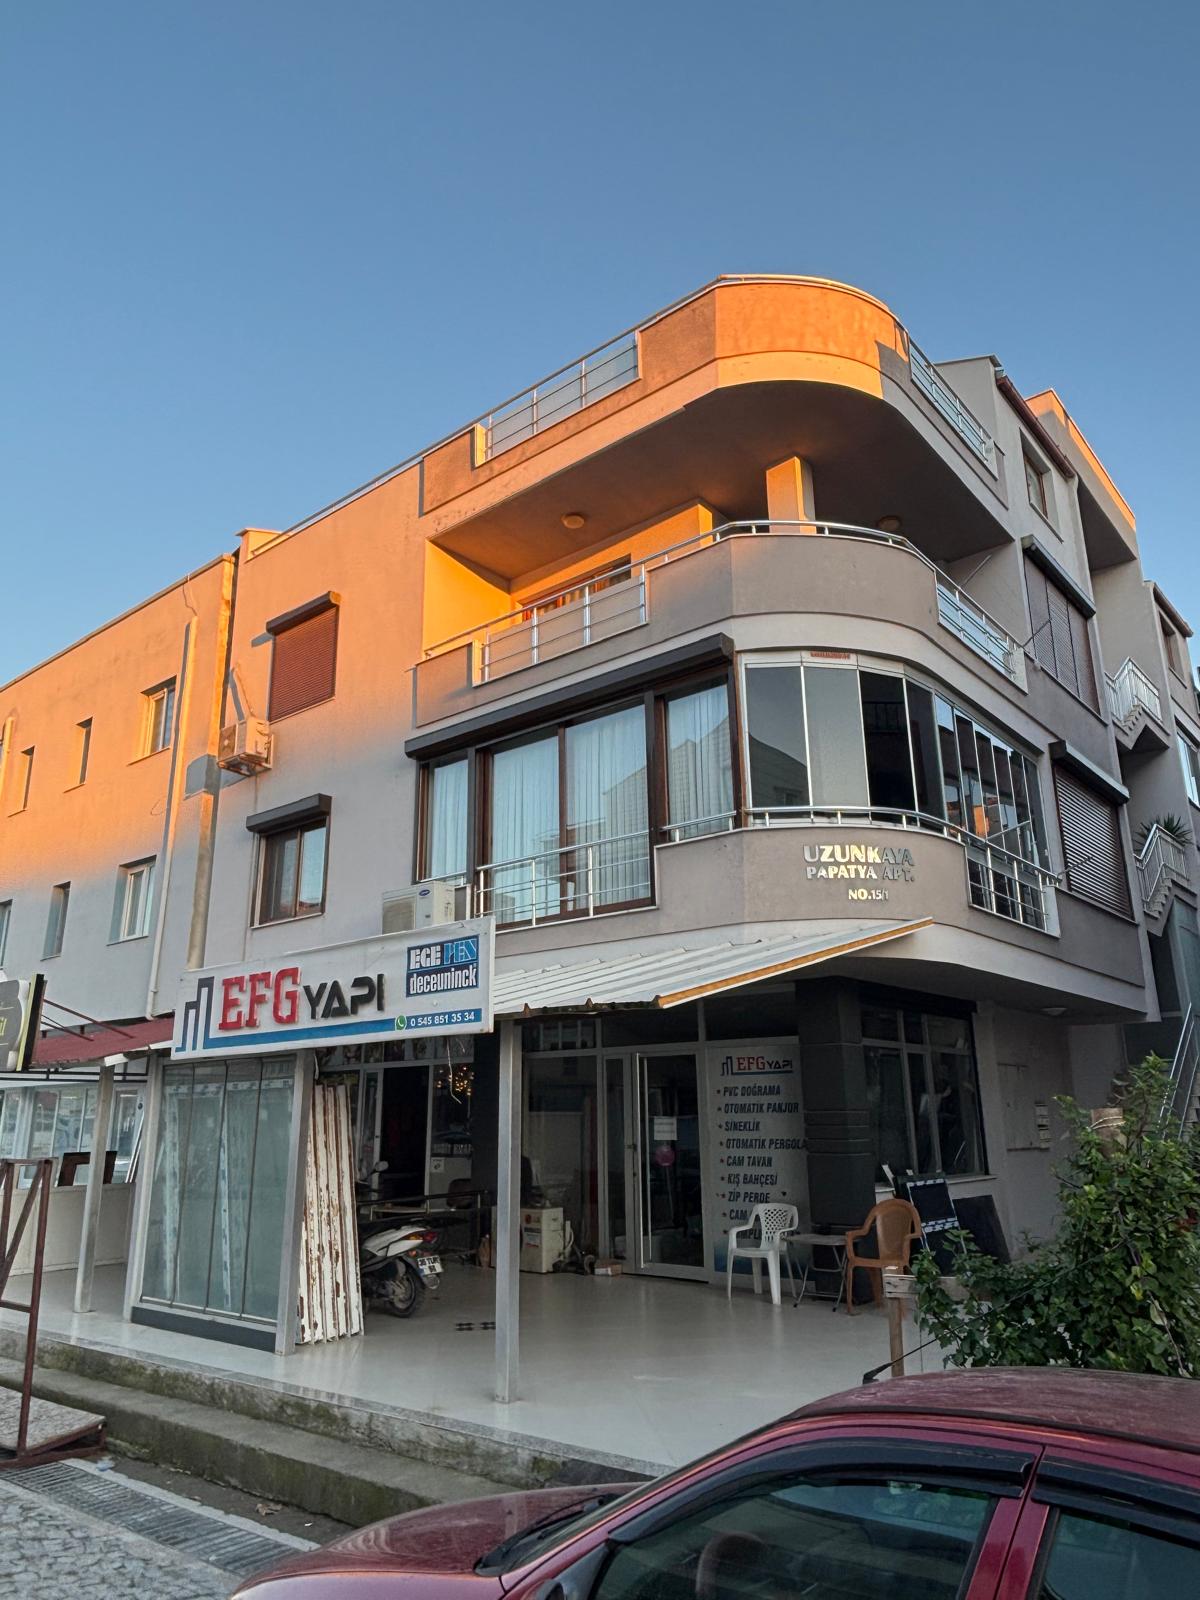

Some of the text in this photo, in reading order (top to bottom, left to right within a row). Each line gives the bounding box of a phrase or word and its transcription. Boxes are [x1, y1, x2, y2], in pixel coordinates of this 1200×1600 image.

[803, 844, 915, 866] UZUNKAYA
[806, 865, 915, 882] PAPATYA APT.
[410, 938, 477, 970] EGE PEN
[409, 964, 477, 995] deceuninck
[218, 967, 385, 1031] EFG YAPI
[410, 1011, 475, 1027] 0 545 851 35 34
[736, 1056, 793, 1071] EFG YAPI
[723, 1083, 781, 1097] PVC DOĞRAMA
[724, 1118, 761, 1132] SİNEKLİK
[726, 1156, 773, 1168] CAM TAVAN
[727, 1172, 778, 1187] KIŞ BAHÇESİ
[743, 1191, 770, 1204] PERDE
[729, 1208, 748, 1220] CAM
